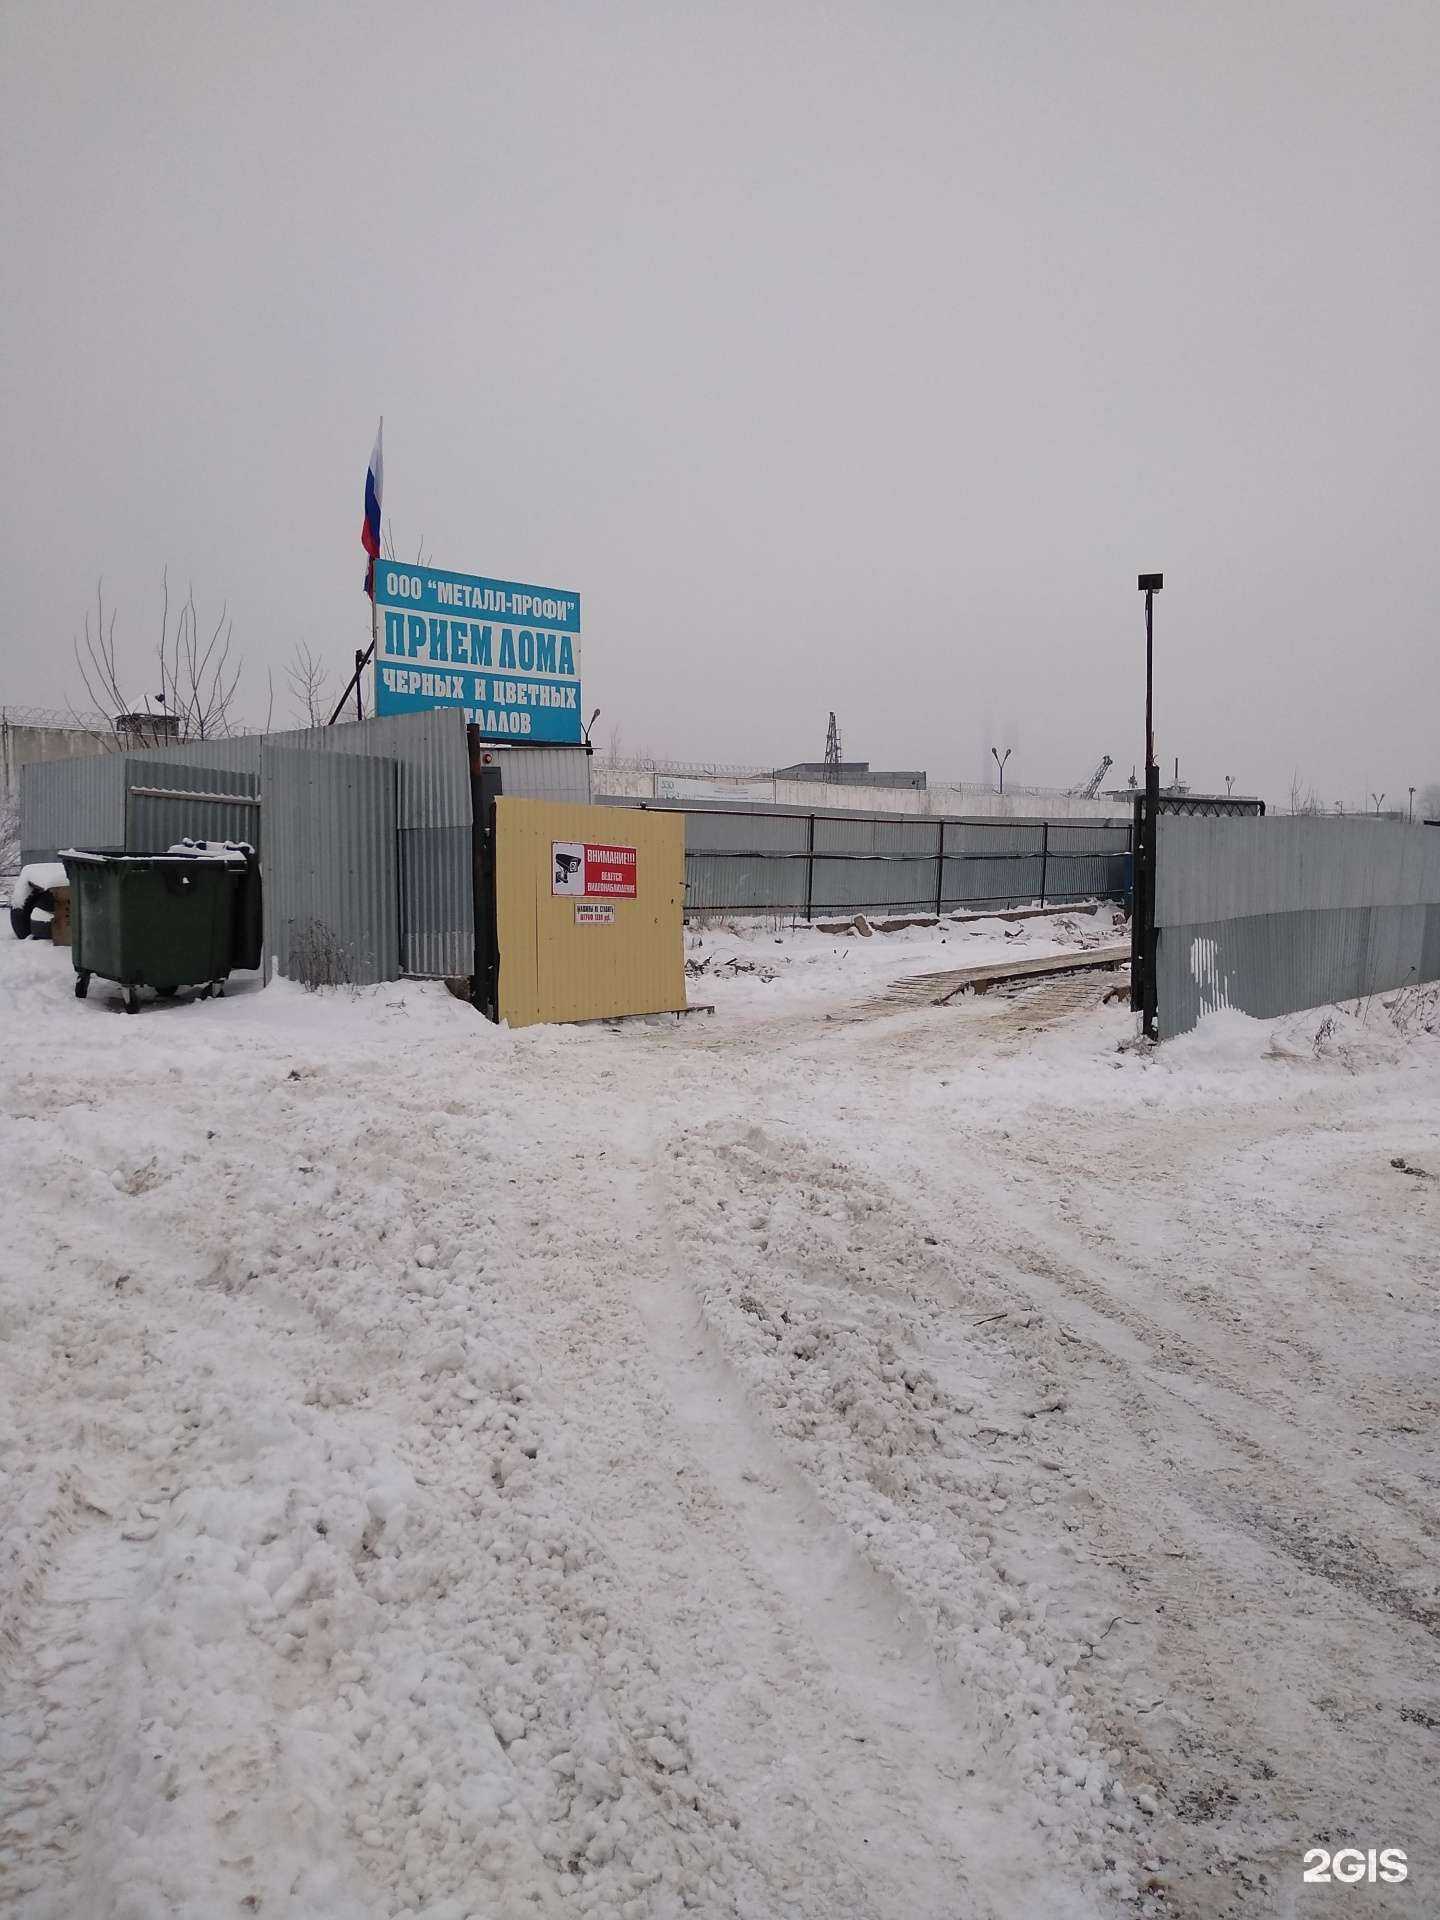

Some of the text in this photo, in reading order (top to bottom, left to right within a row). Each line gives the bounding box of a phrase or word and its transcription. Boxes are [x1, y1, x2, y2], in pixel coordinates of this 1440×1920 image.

[386, 572, 422, 600] ООО
[384, 611, 575, 675] ПРИЕМ ЛОМА
[382, 668, 577, 709] ЧЕРНЫХ И ЦВЕТНЫХ
[434, 706, 532, 734] ТАЛЛОВ
[587, 882, 635, 893] ВИДЕОНАБЛЮДЕНИЕ
[601, 871, 623, 881] ВЕДЕТСЯ
